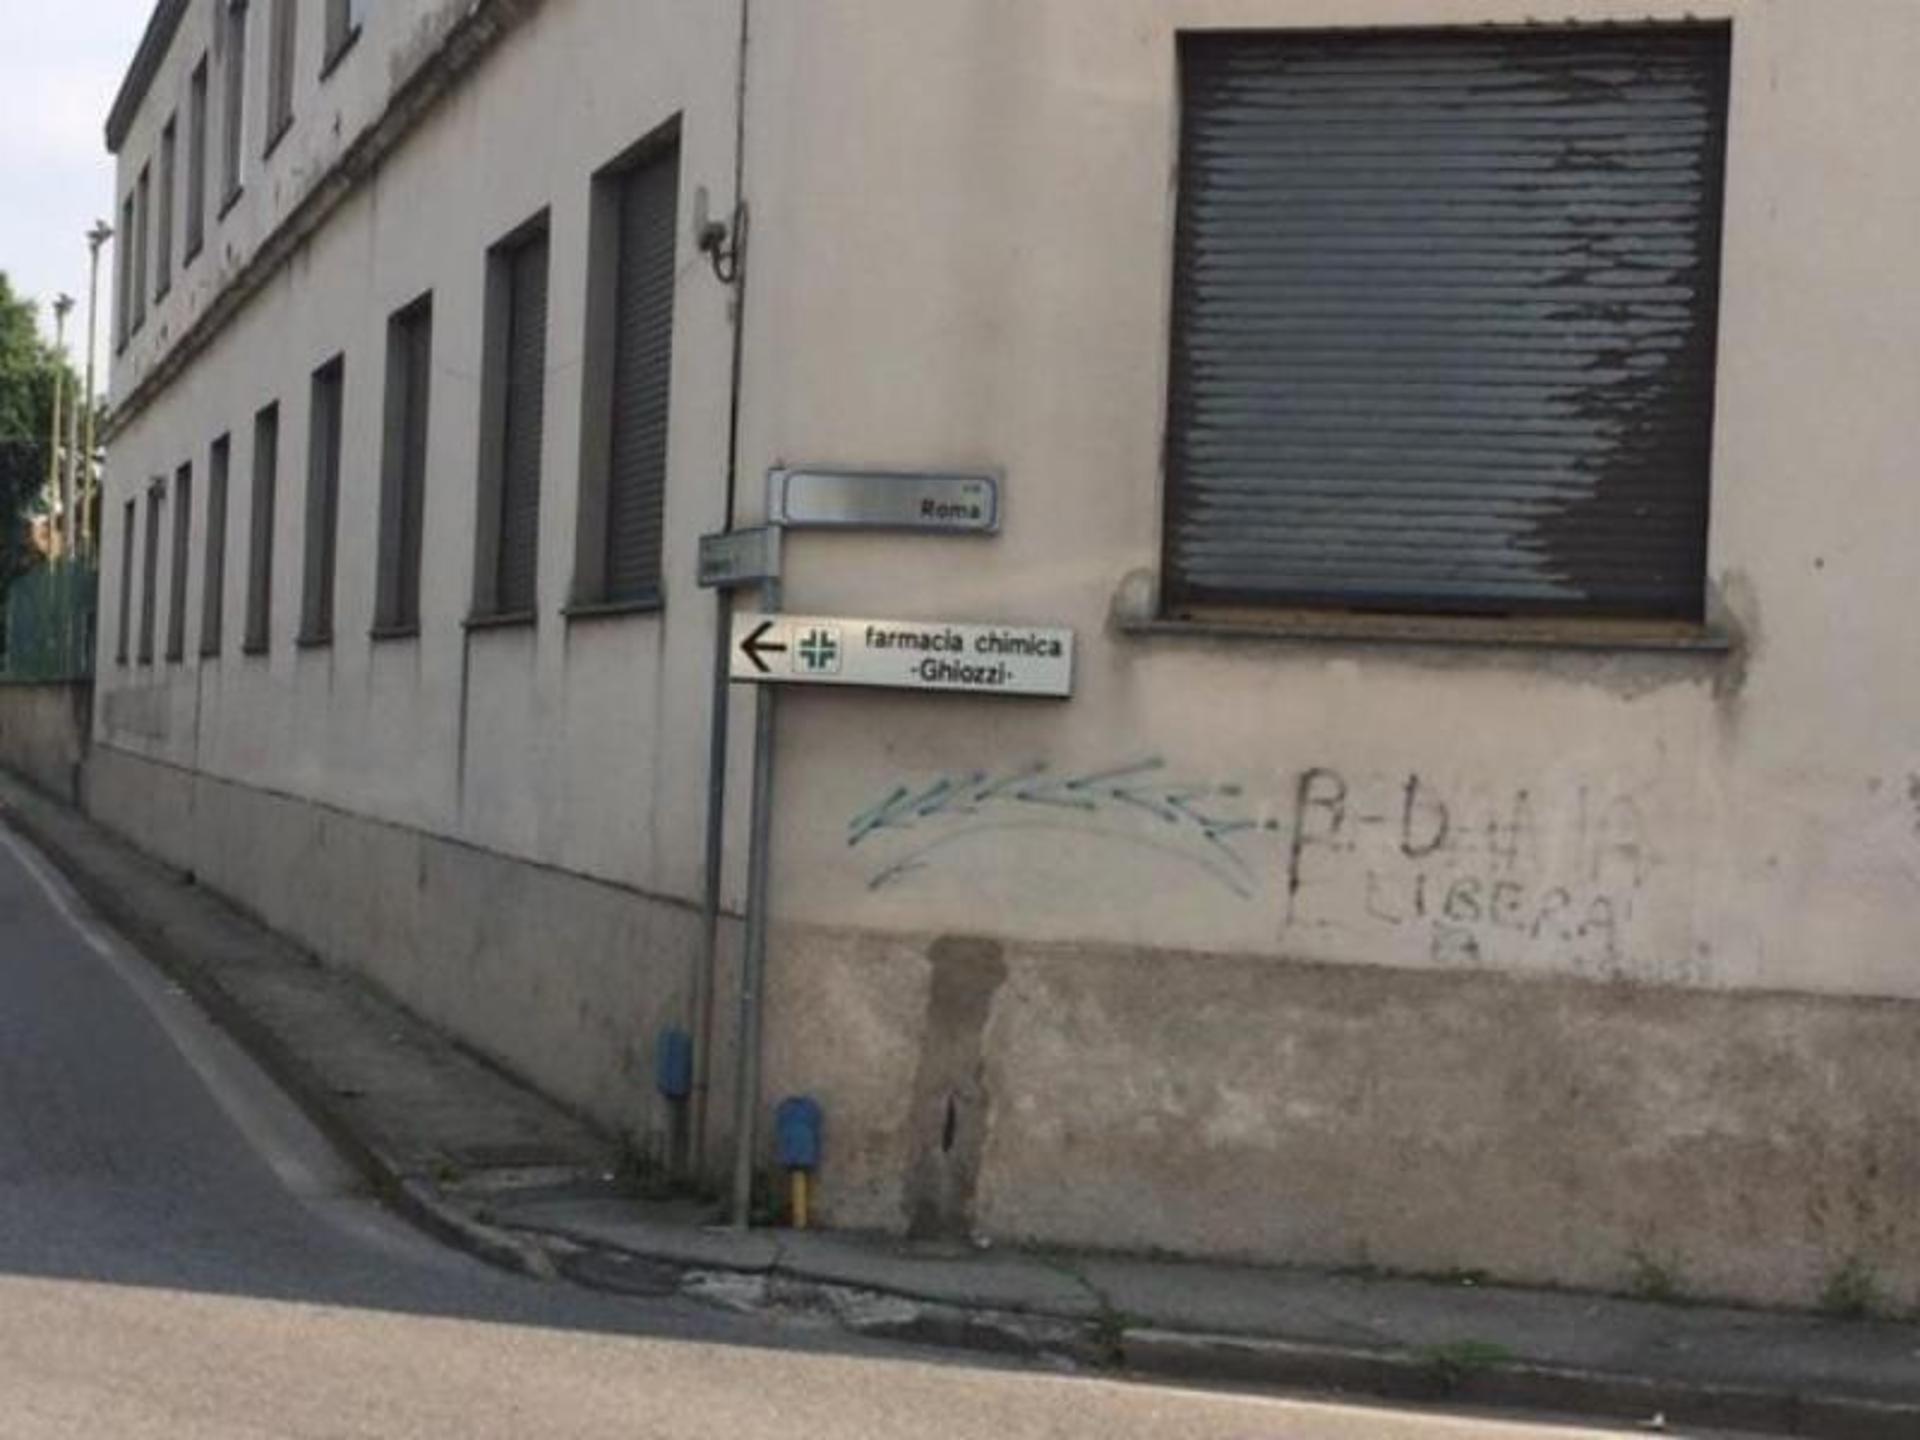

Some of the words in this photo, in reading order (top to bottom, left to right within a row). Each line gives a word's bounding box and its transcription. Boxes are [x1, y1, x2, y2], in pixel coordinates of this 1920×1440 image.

[920, 498, 980, 519] Roma
[865, 623, 963, 651] farmacia
[974, 630, 1062, 657] chimica
